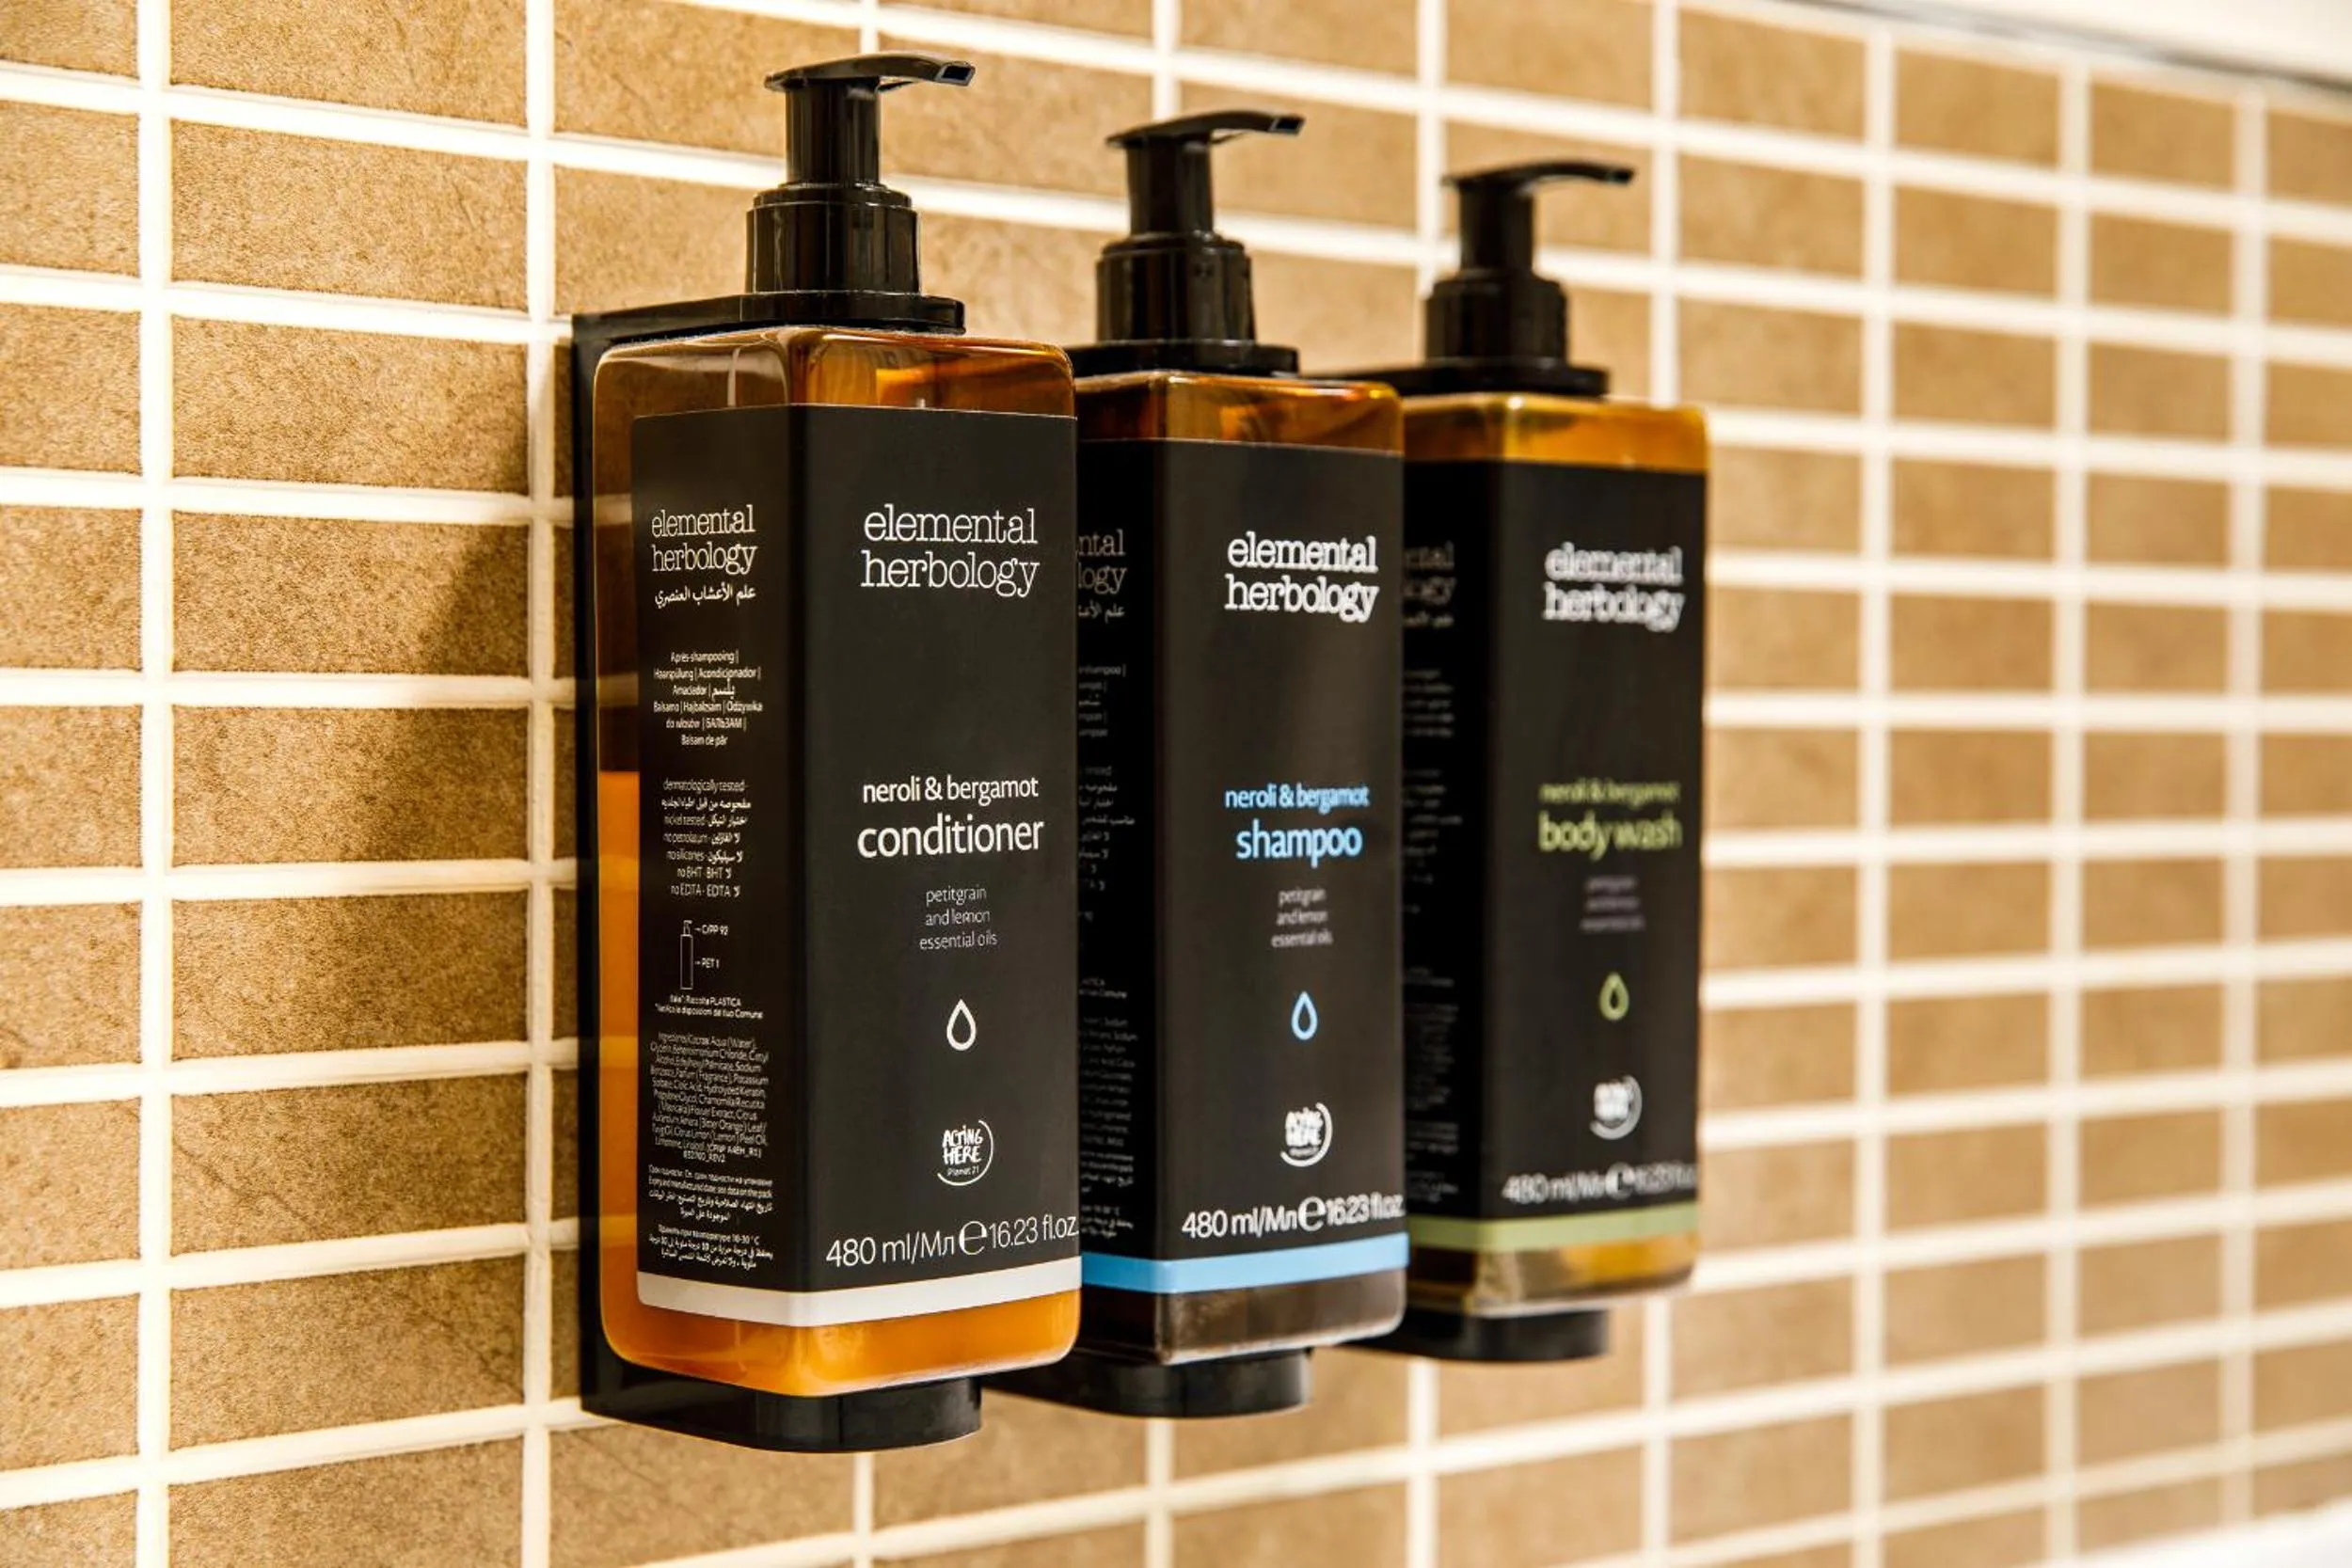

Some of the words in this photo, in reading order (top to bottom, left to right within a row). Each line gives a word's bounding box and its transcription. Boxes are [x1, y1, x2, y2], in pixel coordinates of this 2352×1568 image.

[651, 504, 755, 538] elemental
[865, 503, 1039, 545] elemental
[651, 541, 757, 575] herbology
[1227, 531, 1379, 574] elemental
[1545, 541, 1684, 587] elemental
[861, 550, 1041, 598] herbology
[1224, 574, 1380, 623] herbology
[1542, 581, 1686, 633] herbology
[863, 776, 922, 804] neroli
[924, 776, 943, 801] &
[946, 774, 1040, 807] bergamot
[1225, 782, 1278, 810] neroli
[1279, 783, 1295, 809] &
[1296, 781, 1371, 816] bergamot
[857, 813, 1045, 859] conditioner
[1235, 818, 1364, 869] shampoo
[1538, 809, 1613, 863] body
[1613, 809, 1683, 851] wash
[925, 884, 987, 908] petitgrain
[925, 908, 950, 927] and
[951, 908, 991, 925] lemon
[919, 930, 975, 950] essential
[977, 928, 998, 947] oils
[943, 1145, 981, 1165] HERE
[825, 1237, 877, 1268] 480
[989, 1216, 1040, 1250] 16.23
[1182, 1210, 1229, 1239] 480
